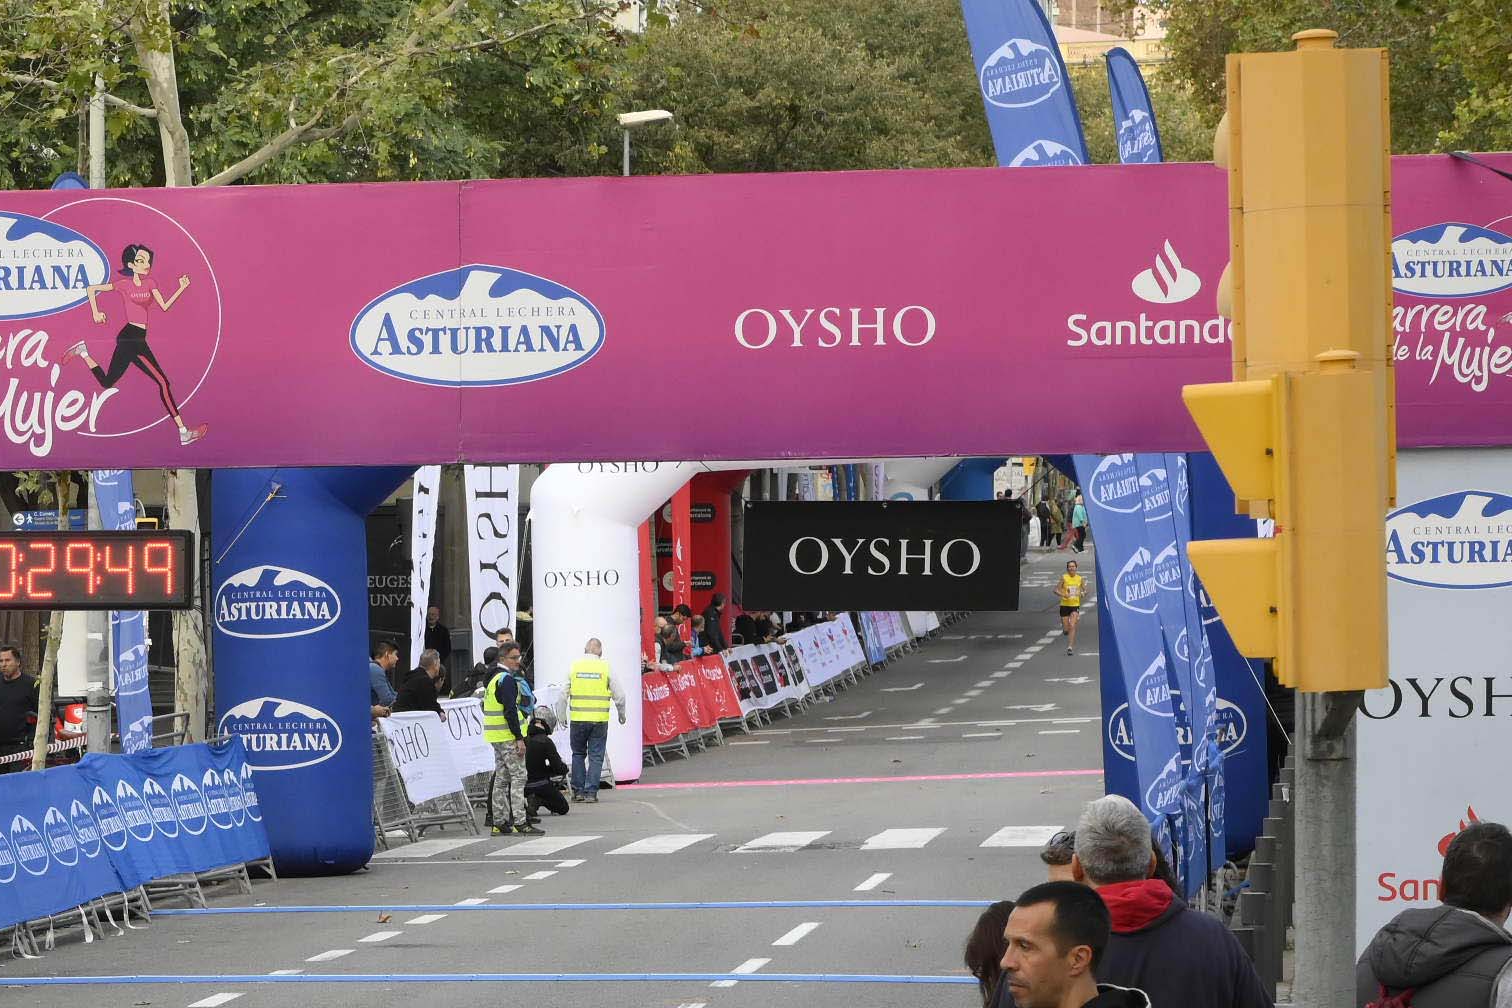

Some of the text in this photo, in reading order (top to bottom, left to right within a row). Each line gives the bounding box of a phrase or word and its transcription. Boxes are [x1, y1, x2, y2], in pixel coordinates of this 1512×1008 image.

[12, 248, 85, 260] LECHERA
[1406, 248, 1458, 256] CENTRAL
[409, 306, 576, 320] CENTRAL LECHERA
[1392, 303, 1488, 332] arrera
[370, 312, 586, 356] ASTURIANA
[734, 305, 936, 350] OYSHO
[1066, 313, 1233, 346] Santand
[1416, 333, 1434, 360] la
[1429, 327, 1512, 392] Muje
[1414, 526, 1480, 536] CENTRAL
[788, 536, 981, 577] OYSHO
[544, 569, 620, 589] OYSHO
[219, 594, 332, 622] ASTURIANA
[232, 590, 326, 599] CENTRAL LECHERA
[1358, 676, 1512, 720] OYSH
[232, 722, 328, 731] CENTRAL LECHERA
[447, 705, 482, 740] OYS
